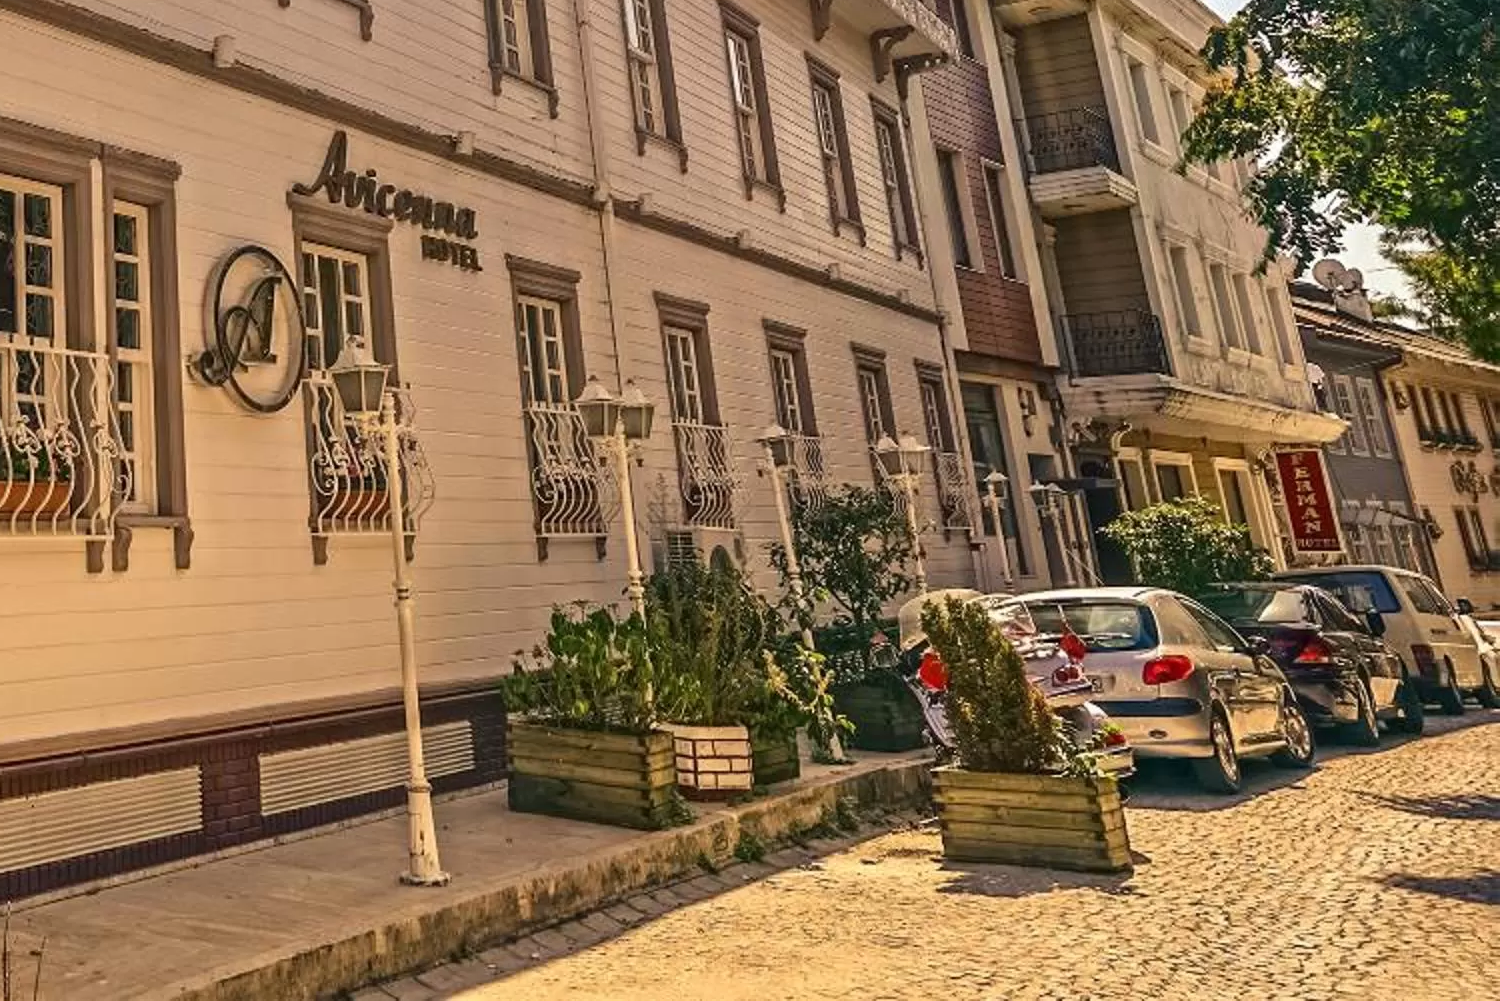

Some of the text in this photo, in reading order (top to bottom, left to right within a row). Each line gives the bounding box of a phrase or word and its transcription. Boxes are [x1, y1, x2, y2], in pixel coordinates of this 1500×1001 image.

[291, 130, 479, 239] Avicenna
[420, 235, 483, 272] HOTEL
[1291, 453, 1322, 534] FERMAN
